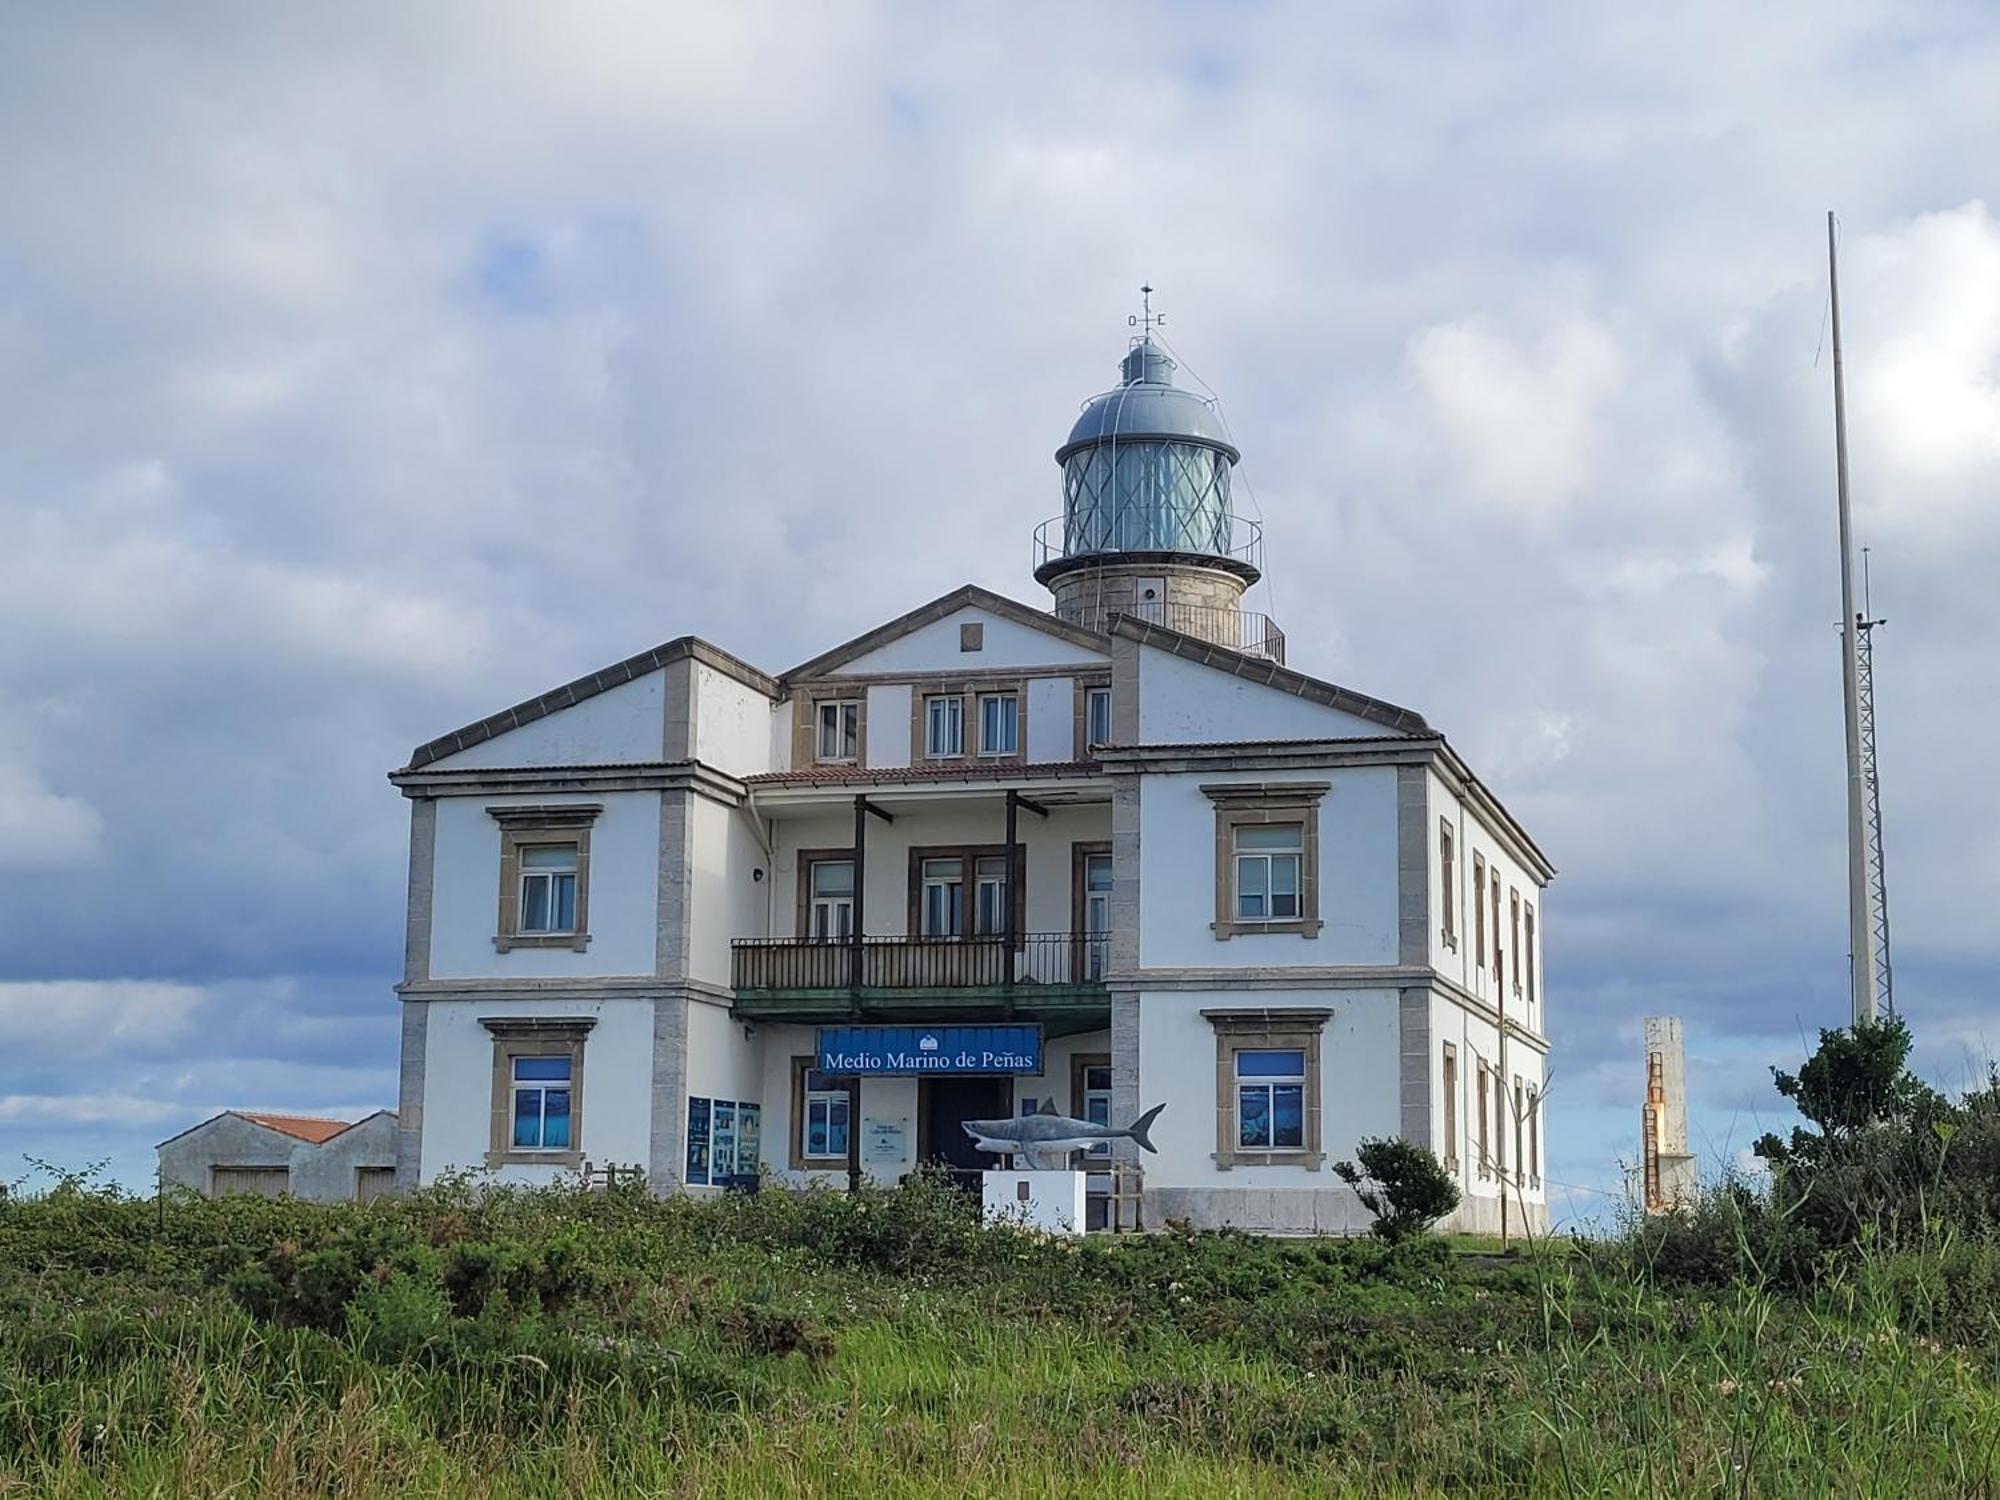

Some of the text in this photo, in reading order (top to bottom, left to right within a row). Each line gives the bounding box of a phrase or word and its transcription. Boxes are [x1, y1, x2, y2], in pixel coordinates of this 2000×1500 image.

[825, 1051, 1033, 1069] Medio Marino de Peñas
